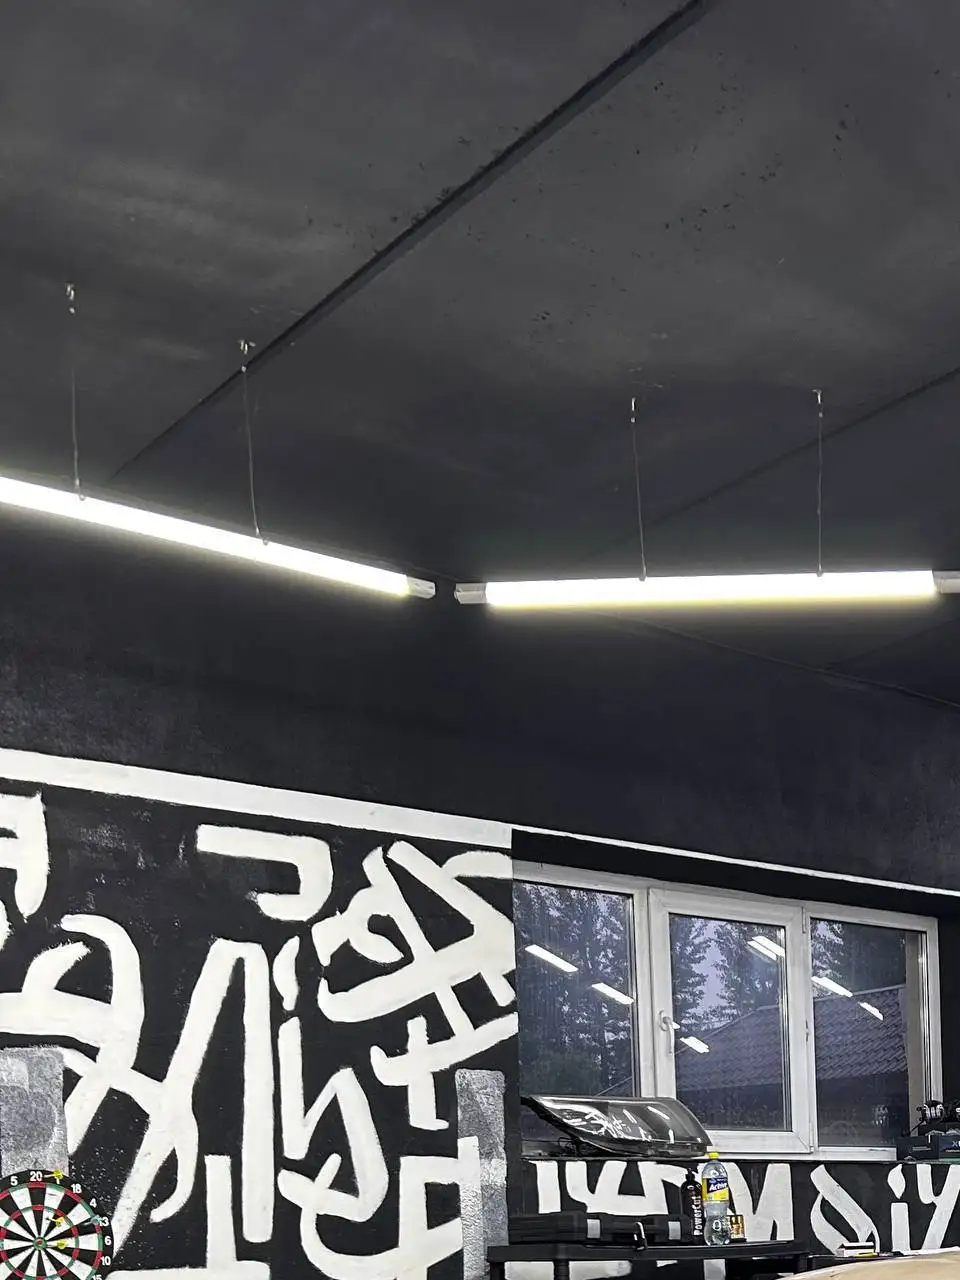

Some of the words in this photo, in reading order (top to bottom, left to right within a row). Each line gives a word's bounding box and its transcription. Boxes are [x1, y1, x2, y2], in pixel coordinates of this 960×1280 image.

[10, 1175, 18, 1186] 5
[29, 1171, 43, 1182] 20
[71, 1183, 83, 1194] 18
[89, 1198, 97, 1208] 4
[691, 1195, 703, 1236] PowerCut
[104, 1237, 112, 1246] 6
[100, 1256, 112, 1266] 10
